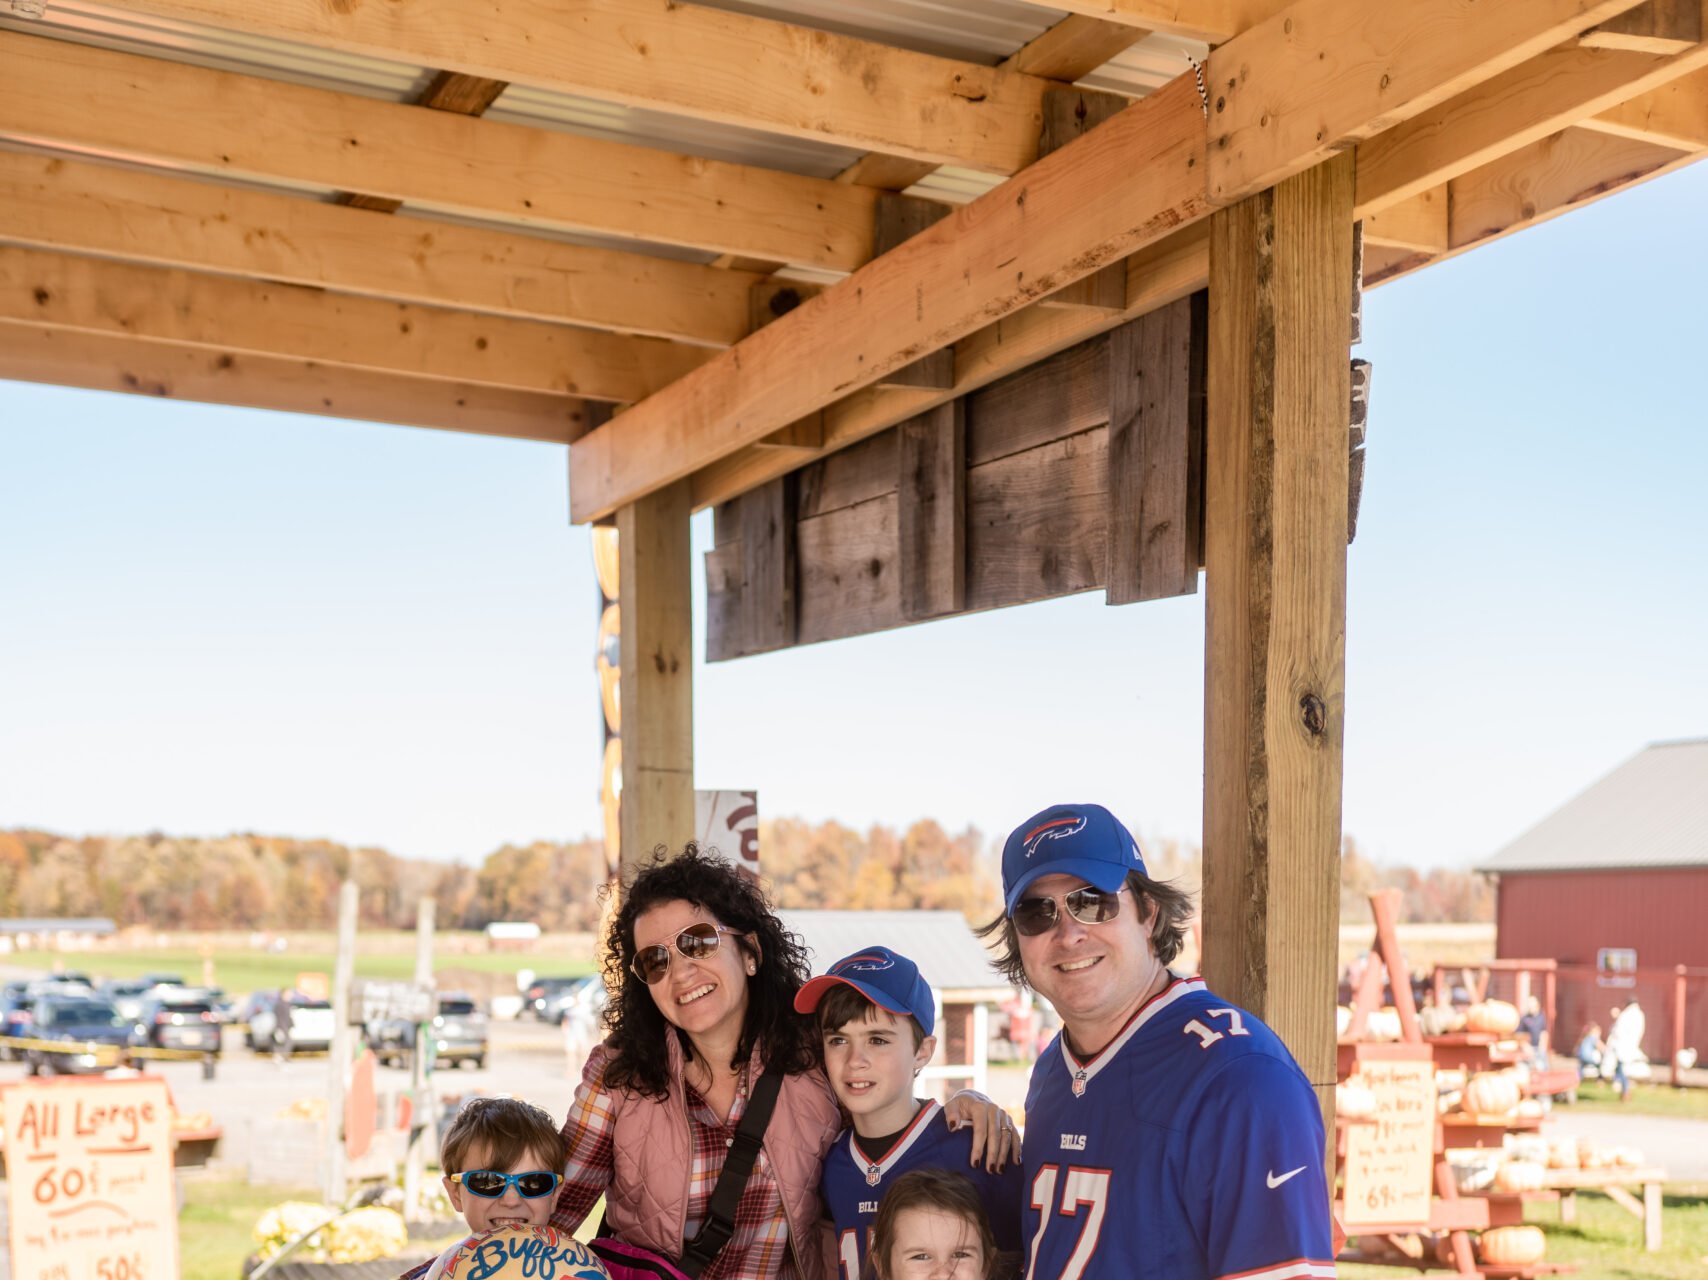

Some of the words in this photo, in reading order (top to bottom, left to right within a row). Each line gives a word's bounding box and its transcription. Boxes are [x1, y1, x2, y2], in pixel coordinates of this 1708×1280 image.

[1183, 1008, 1250, 1049] 17
[17, 1100, 59, 1150] All
[74, 1098, 156, 1144] Large
[1060, 1134, 1087, 1151] BILLS
